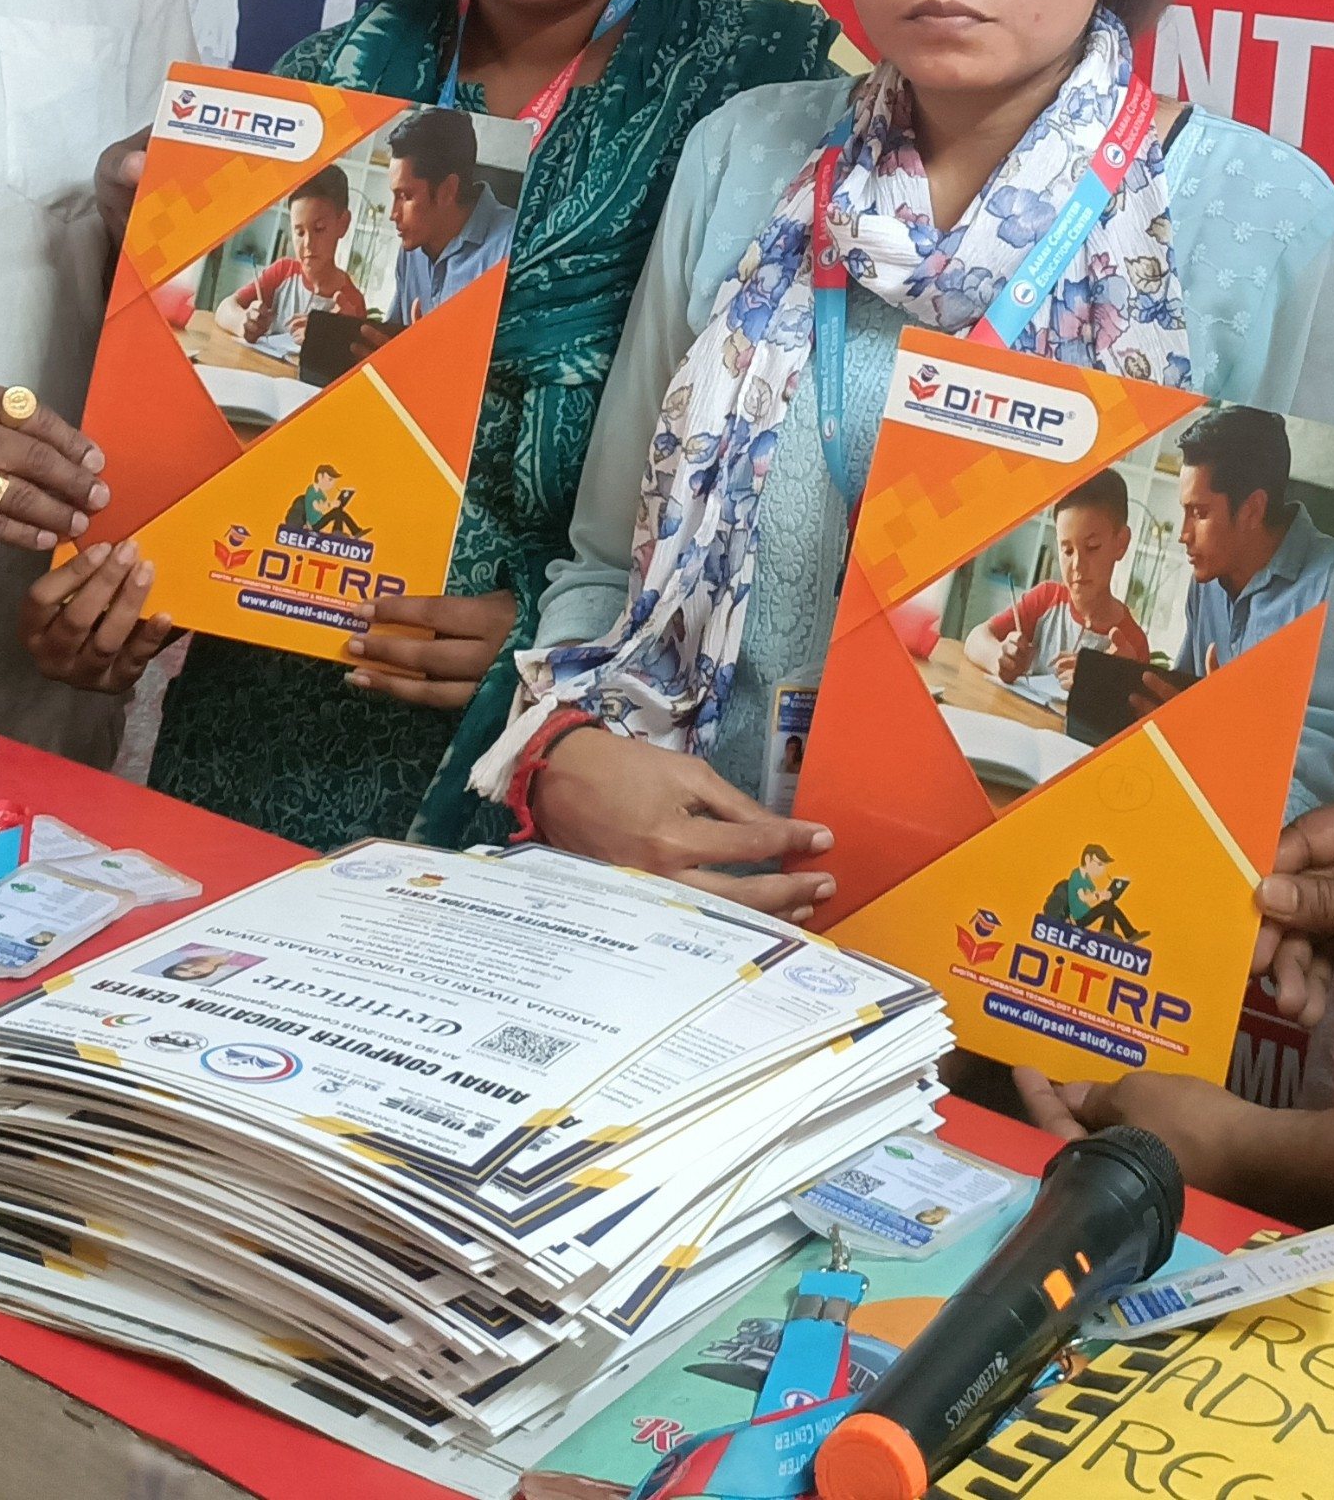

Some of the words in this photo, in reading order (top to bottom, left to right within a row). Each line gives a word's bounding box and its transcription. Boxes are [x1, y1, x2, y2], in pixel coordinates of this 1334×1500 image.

[944, 383, 1065, 432] DiTRP
[278, 529, 371, 562] SELF-STUDY
[440, 898, 513, 920] EDUCATION
[514, 913, 589, 938] COMPUTER
[205, 926, 272, 946] TIWARI
[273, 938, 344, 960] KUMAR
[1034, 922, 1148, 974] SELF-STUDY
[344, 954, 406, 976] VINOD
[408, 969, 447, 986] D/O
[91, 979, 182, 1006] CENTER
[449, 980, 521, 1007] TIWARI
[1008, 943, 1192, 1031] DiTRP
[179, 997, 311, 1038] EDUCATION
[252, 974, 463, 1038] Certificate
[525, 1000, 623, 1037] SHARDHA
[988, 997, 1145, 1063] www.ditrpself-study.com
[308, 1029, 442, 1077] COMPUTER
[441, 1071, 532, 1105] AARAV
[945, 1361, 998, 1431] ZEBRONICS
[774, 1424, 816, 1451] CENTER
